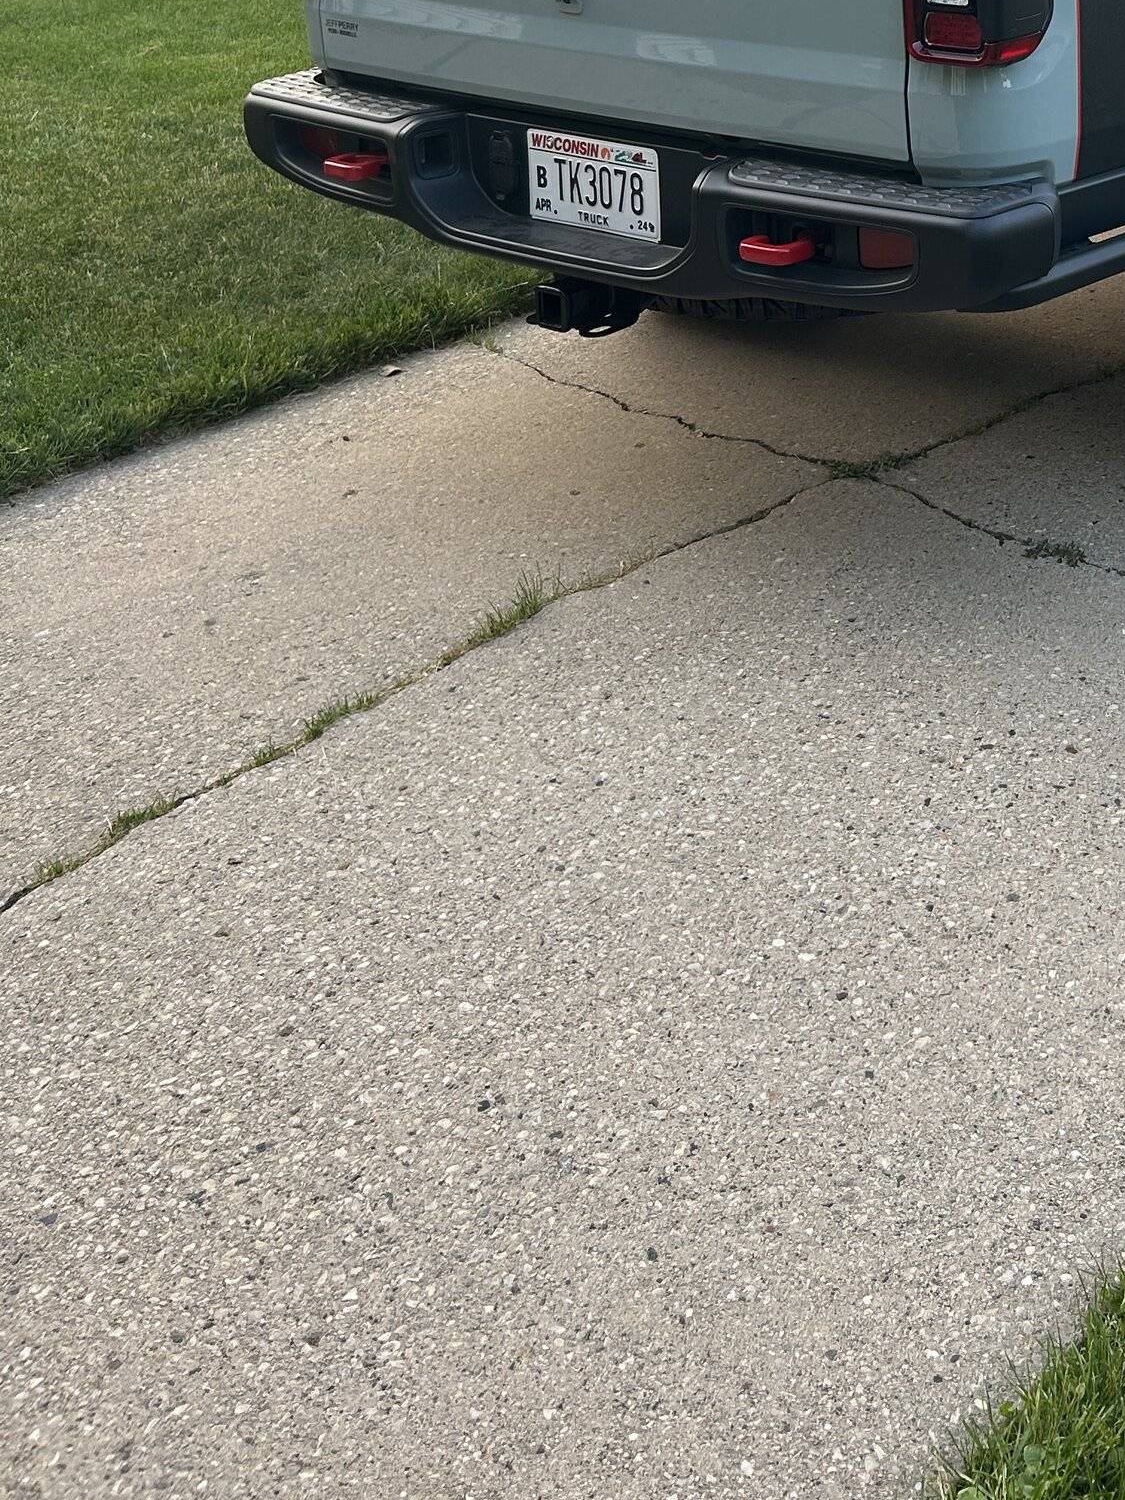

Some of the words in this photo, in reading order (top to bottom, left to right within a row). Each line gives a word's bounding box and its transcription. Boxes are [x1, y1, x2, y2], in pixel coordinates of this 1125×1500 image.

[531, 133, 600, 159] WISCONSIN
[553, 157, 644, 216] TK3078
[535, 197, 552, 212] APR
[578, 210, 609, 227] TRUCK
